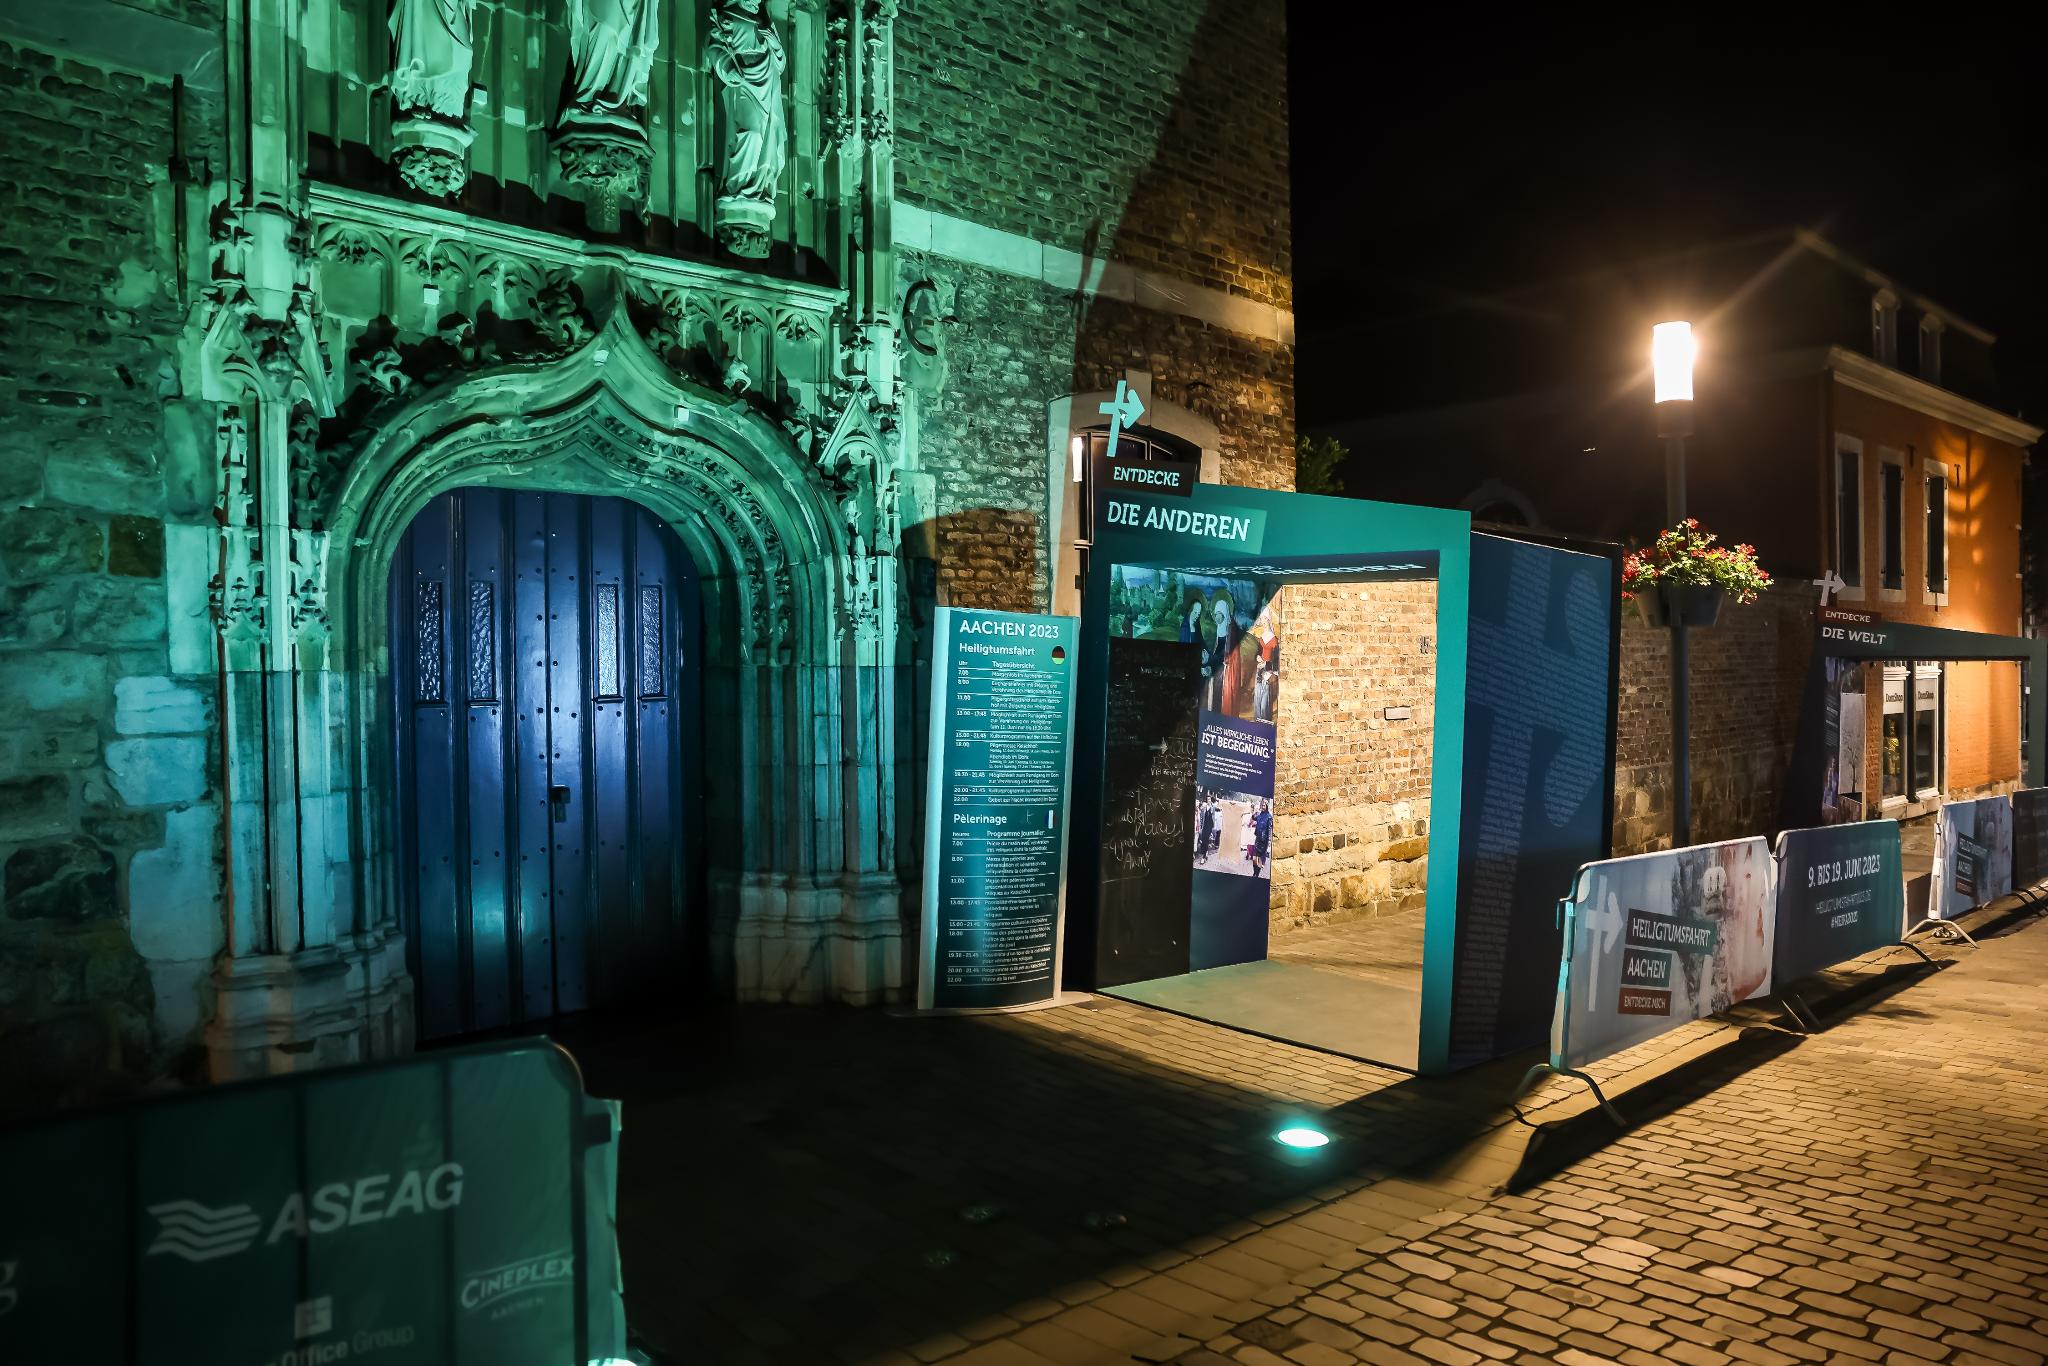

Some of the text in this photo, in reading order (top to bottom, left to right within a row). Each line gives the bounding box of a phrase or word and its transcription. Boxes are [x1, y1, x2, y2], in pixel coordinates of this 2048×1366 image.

[1113, 466, 1180, 487] ENTDECKE
[1107, 501, 1251, 542] DIE ANDEREN
[1825, 611, 1871, 623] ENTDECKE
[959, 620, 1059, 639] AACHEN 2023
[1822, 626, 1887, 645] DIE WELT
[959, 643, 1036, 656] Heiligtumsfahrt
[1201, 732, 1216, 746] IST
[953, 813, 1008, 826] Pèlerinage
[1808, 854, 1880, 889] 9. BIS 19. JUNI 2023
[1632, 917, 1711, 947] HEILIGTUMSFAHRT
[1627, 957, 1667, 979] AACHEN
[1624, 995, 1652, 1008] ENTDECKE
[264, 1162, 463, 1245] ASEAG
[461, 1257, 575, 1309] CINEPLEX
[352, 1326, 415, 1354] Group
